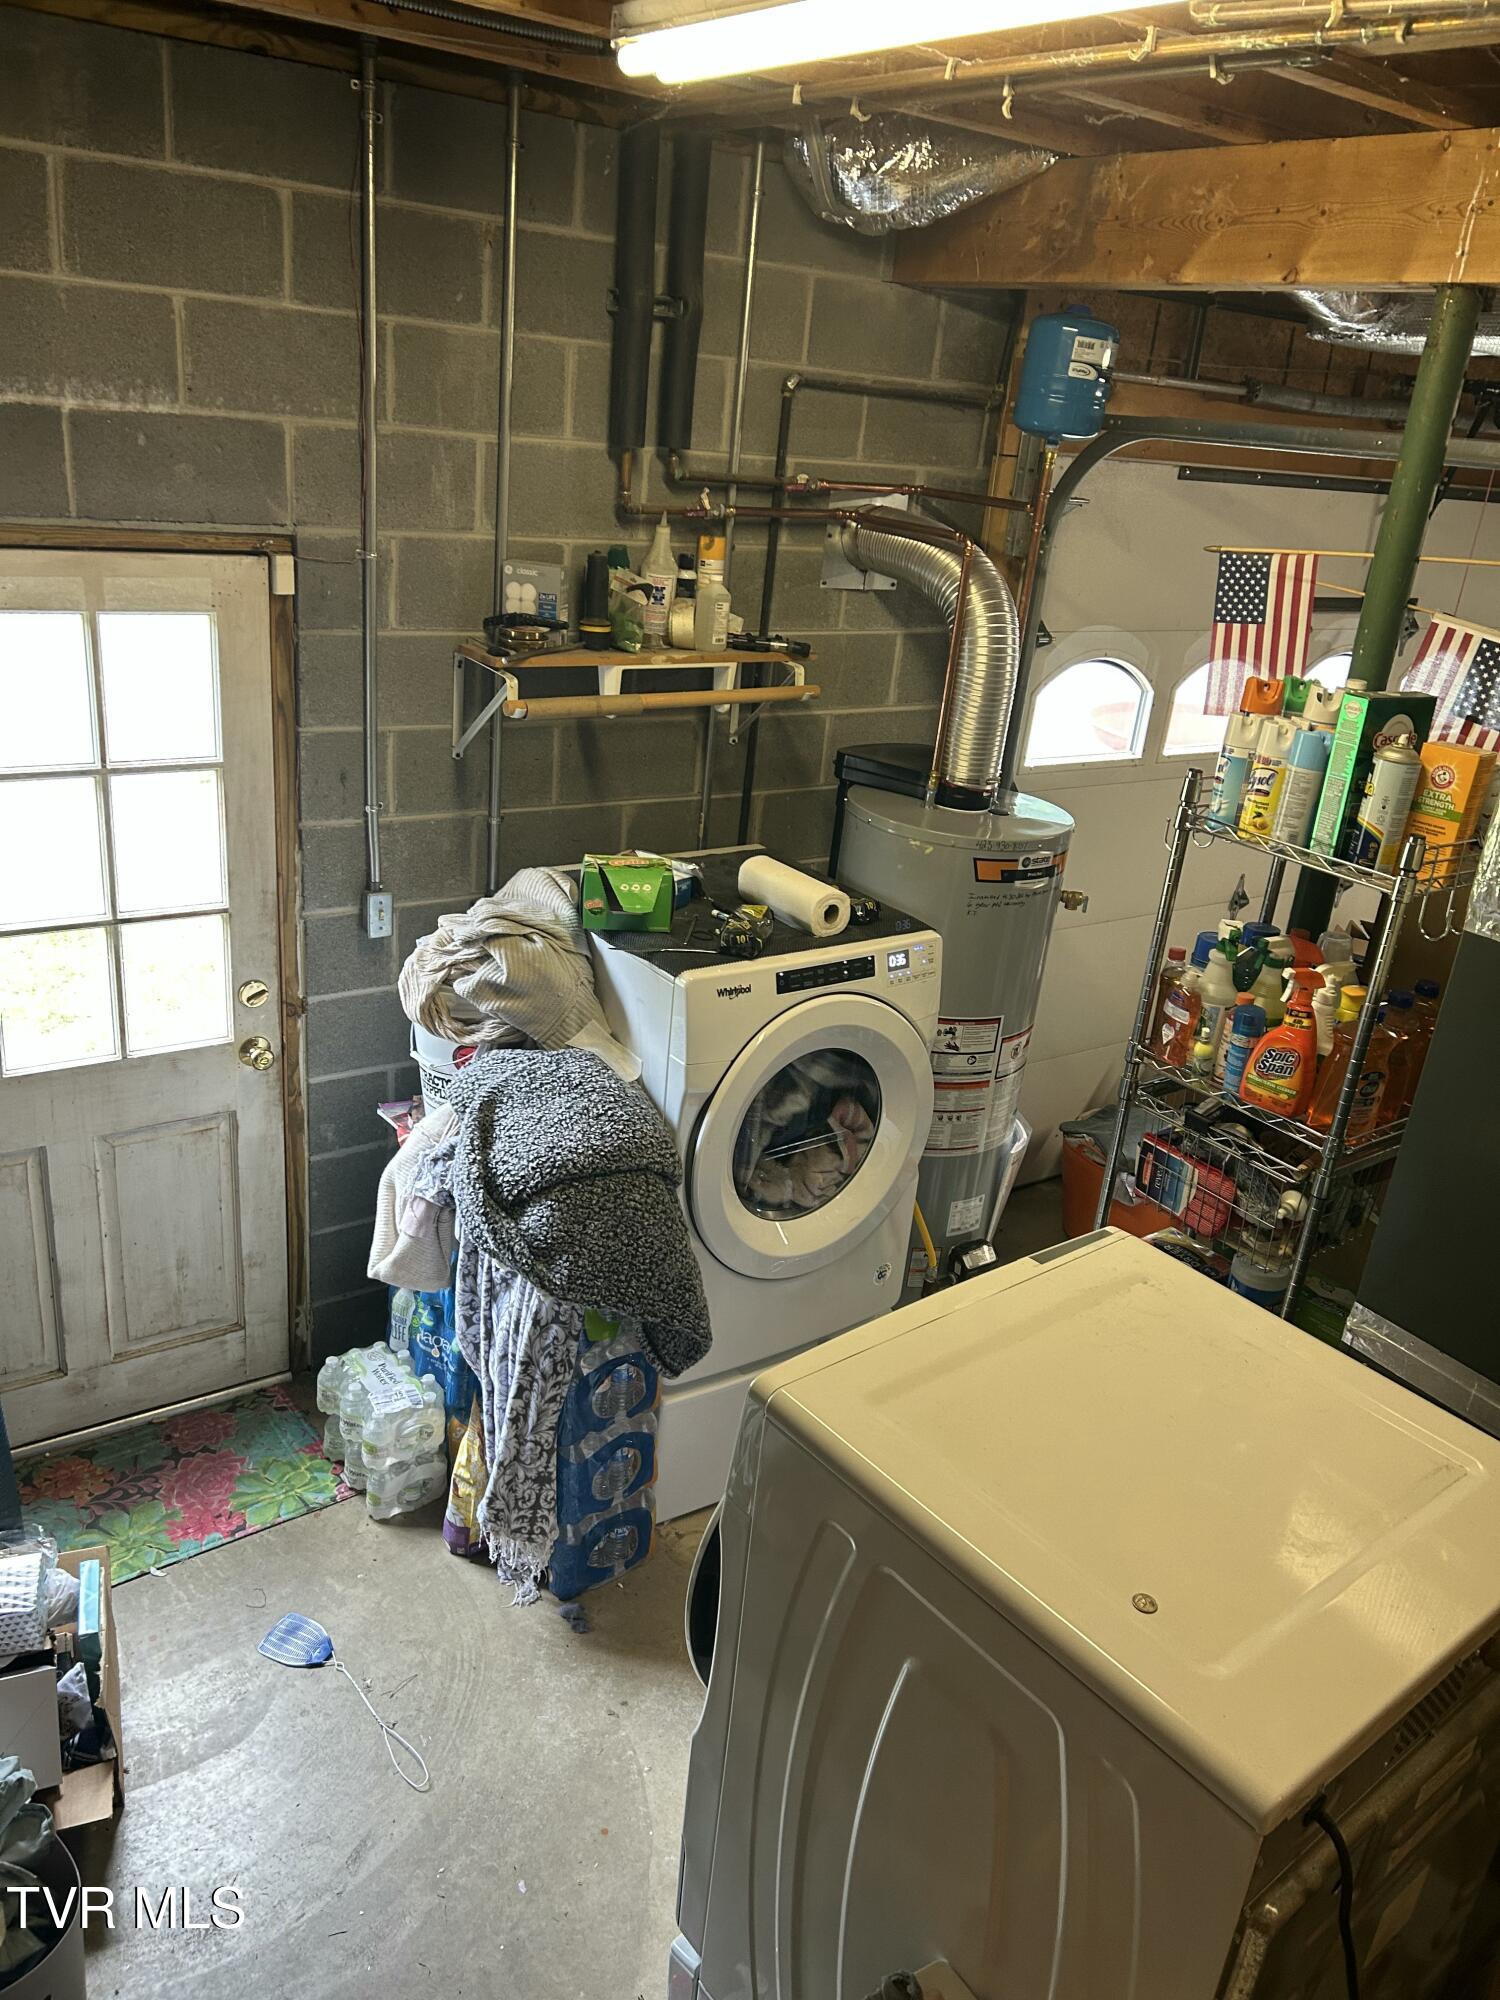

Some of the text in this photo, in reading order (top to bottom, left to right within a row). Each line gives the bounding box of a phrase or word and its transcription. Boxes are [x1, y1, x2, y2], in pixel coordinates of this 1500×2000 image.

[516, 567, 539, 577] classic
[1423, 789, 1452, 802] EXTRA
[1417, 797, 1455, 811] STRENGTH
[717, 983, 752, 1000] Whirlpool
[1263, 1048, 1296, 1064] Spic
[1257, 1059, 1295, 1077] Span
[371, 1368, 389, 1387] Water
[377, 1361, 401, 1386] Purified
